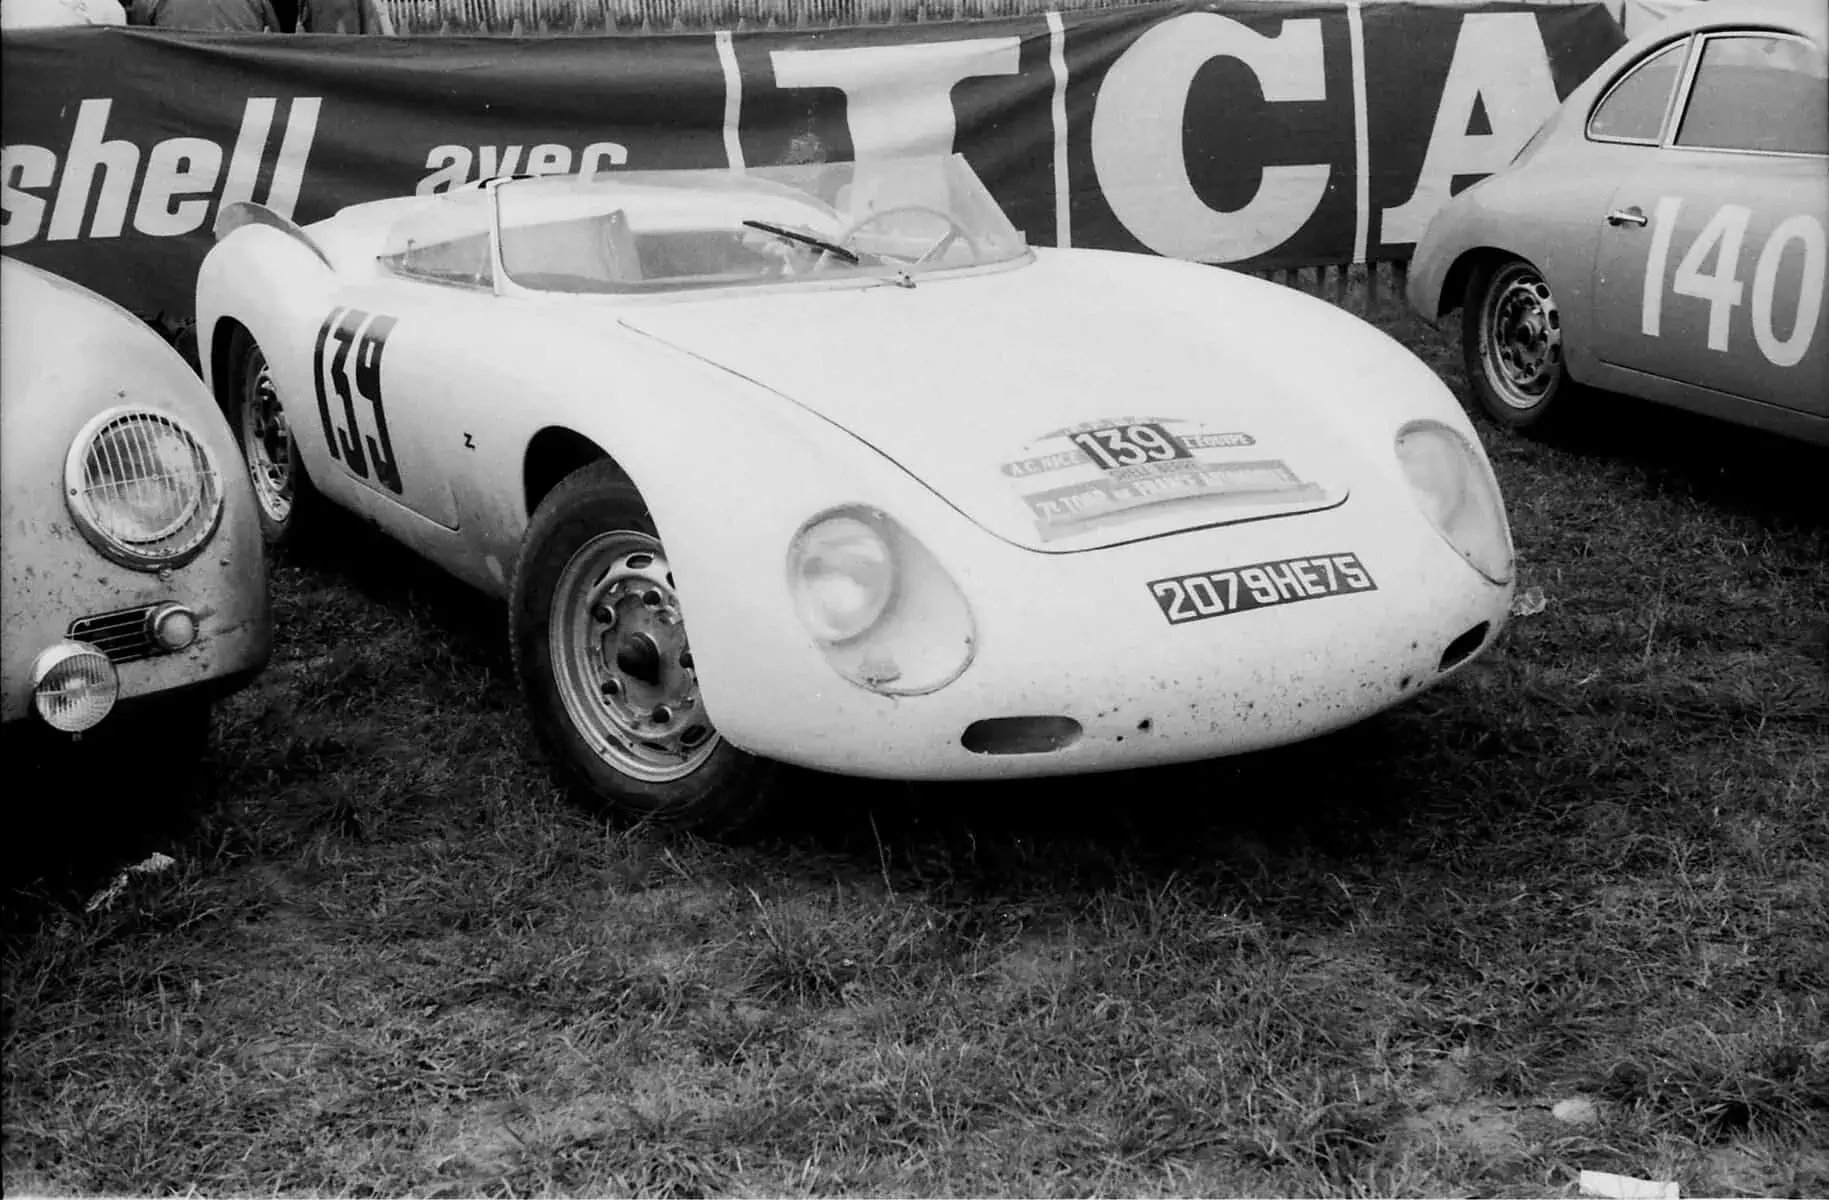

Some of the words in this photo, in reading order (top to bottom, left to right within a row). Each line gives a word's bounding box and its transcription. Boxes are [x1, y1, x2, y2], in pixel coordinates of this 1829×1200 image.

[0, 97, 322, 246] shell
[1642, 196, 1827, 368] 140
[314, 306, 403, 495] 139
[1075, 424, 1176, 469] 139
[1153, 555, 1371, 621] 2079HE75
